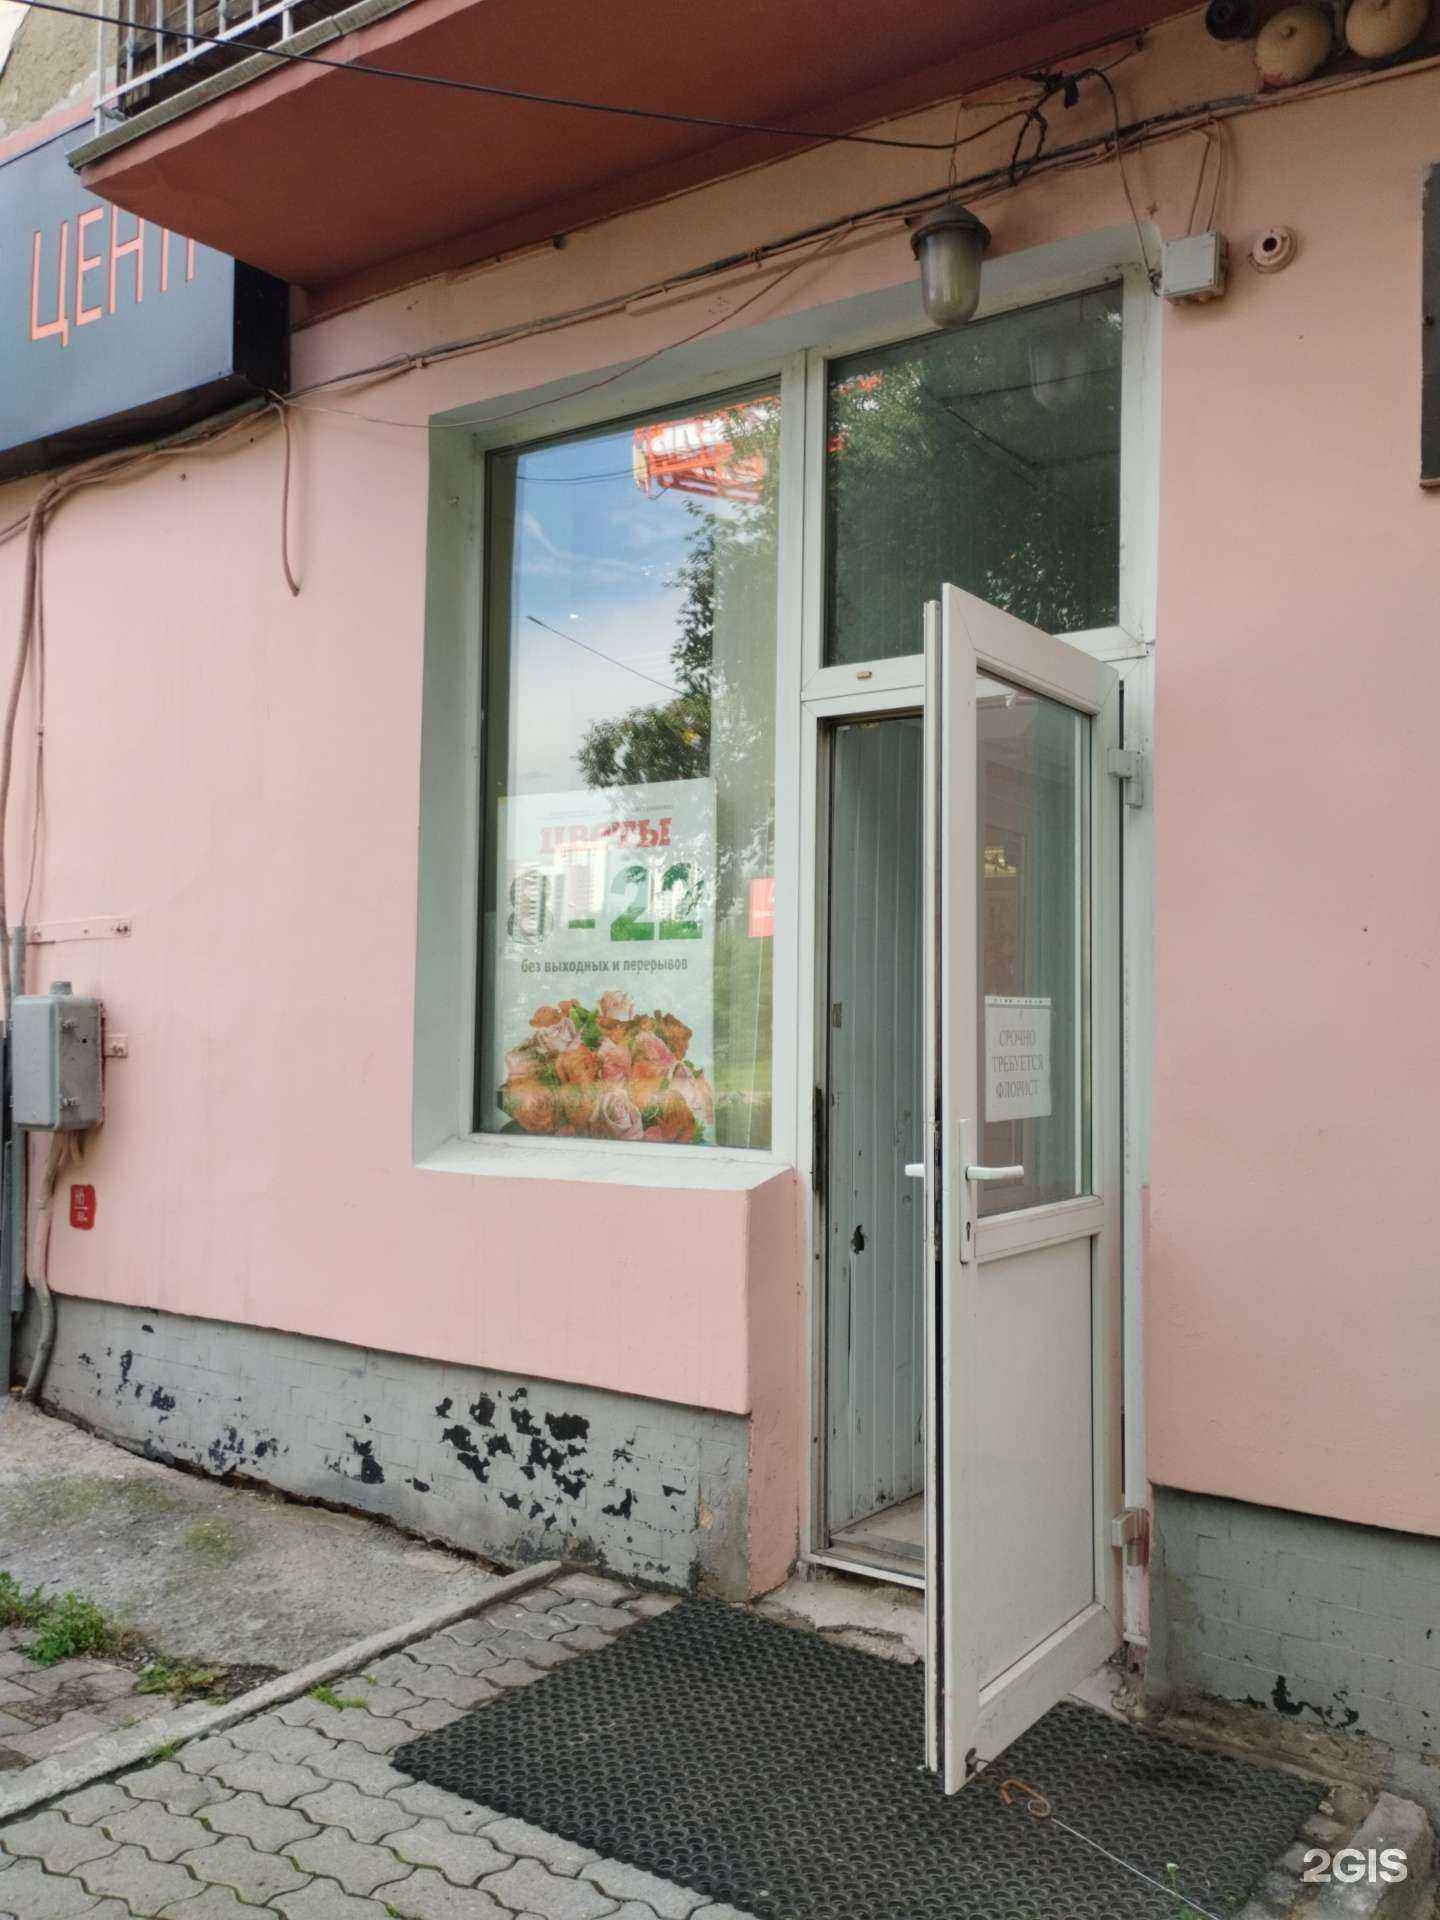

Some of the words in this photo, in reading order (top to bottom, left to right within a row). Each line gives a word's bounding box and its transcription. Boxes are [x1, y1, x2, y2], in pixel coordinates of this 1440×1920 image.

[521, 959, 541, 973] без
[544, 959, 609, 975] выходных
[612, 960, 621, 972] и
[623, 958, 688, 974] перерывов
[999, 1029, 1037, 1048] СРОЧНО
[991, 1054, 1045, 1073] ТРЕБУЕТСЯ
[995, 1079, 1041, 1099] ФЛОРИСТ
